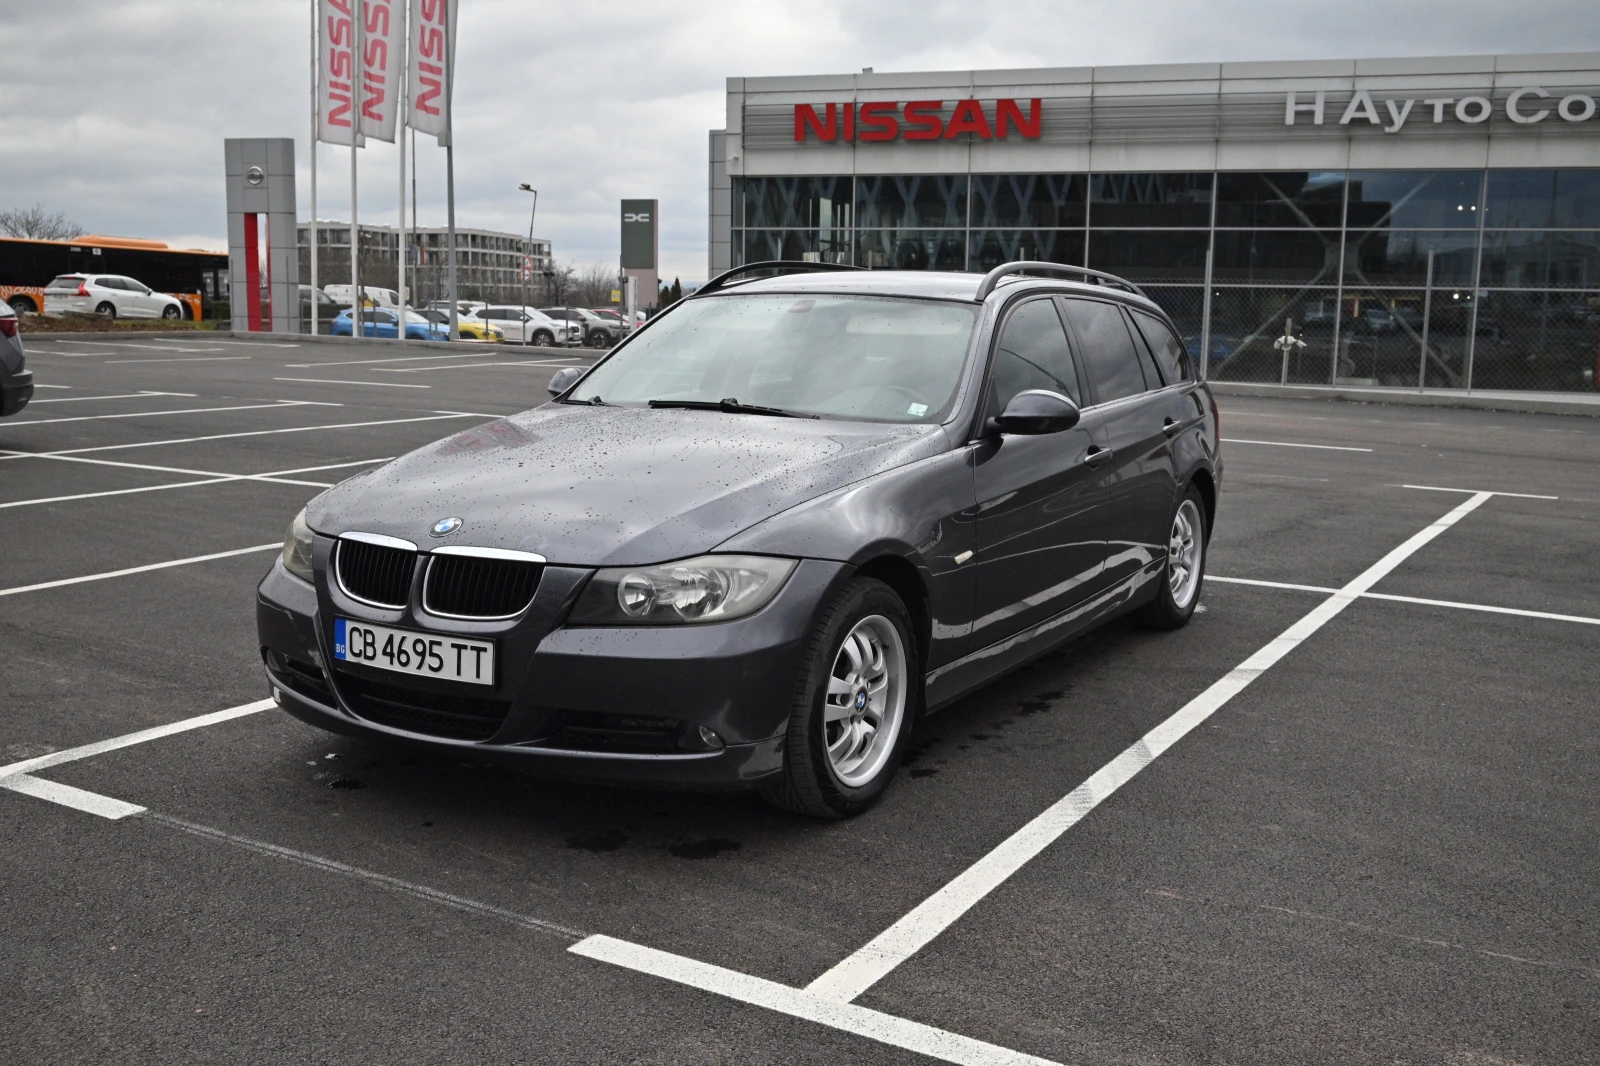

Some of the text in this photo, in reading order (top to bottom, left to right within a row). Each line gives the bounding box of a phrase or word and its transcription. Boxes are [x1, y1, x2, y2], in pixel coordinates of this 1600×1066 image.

[362, 0, 391, 122] NISS
[794, 98, 1042, 142] NISSAN
[335, 644, 346, 654] BG
[349, 626, 488, 679] CB 4695 TT
